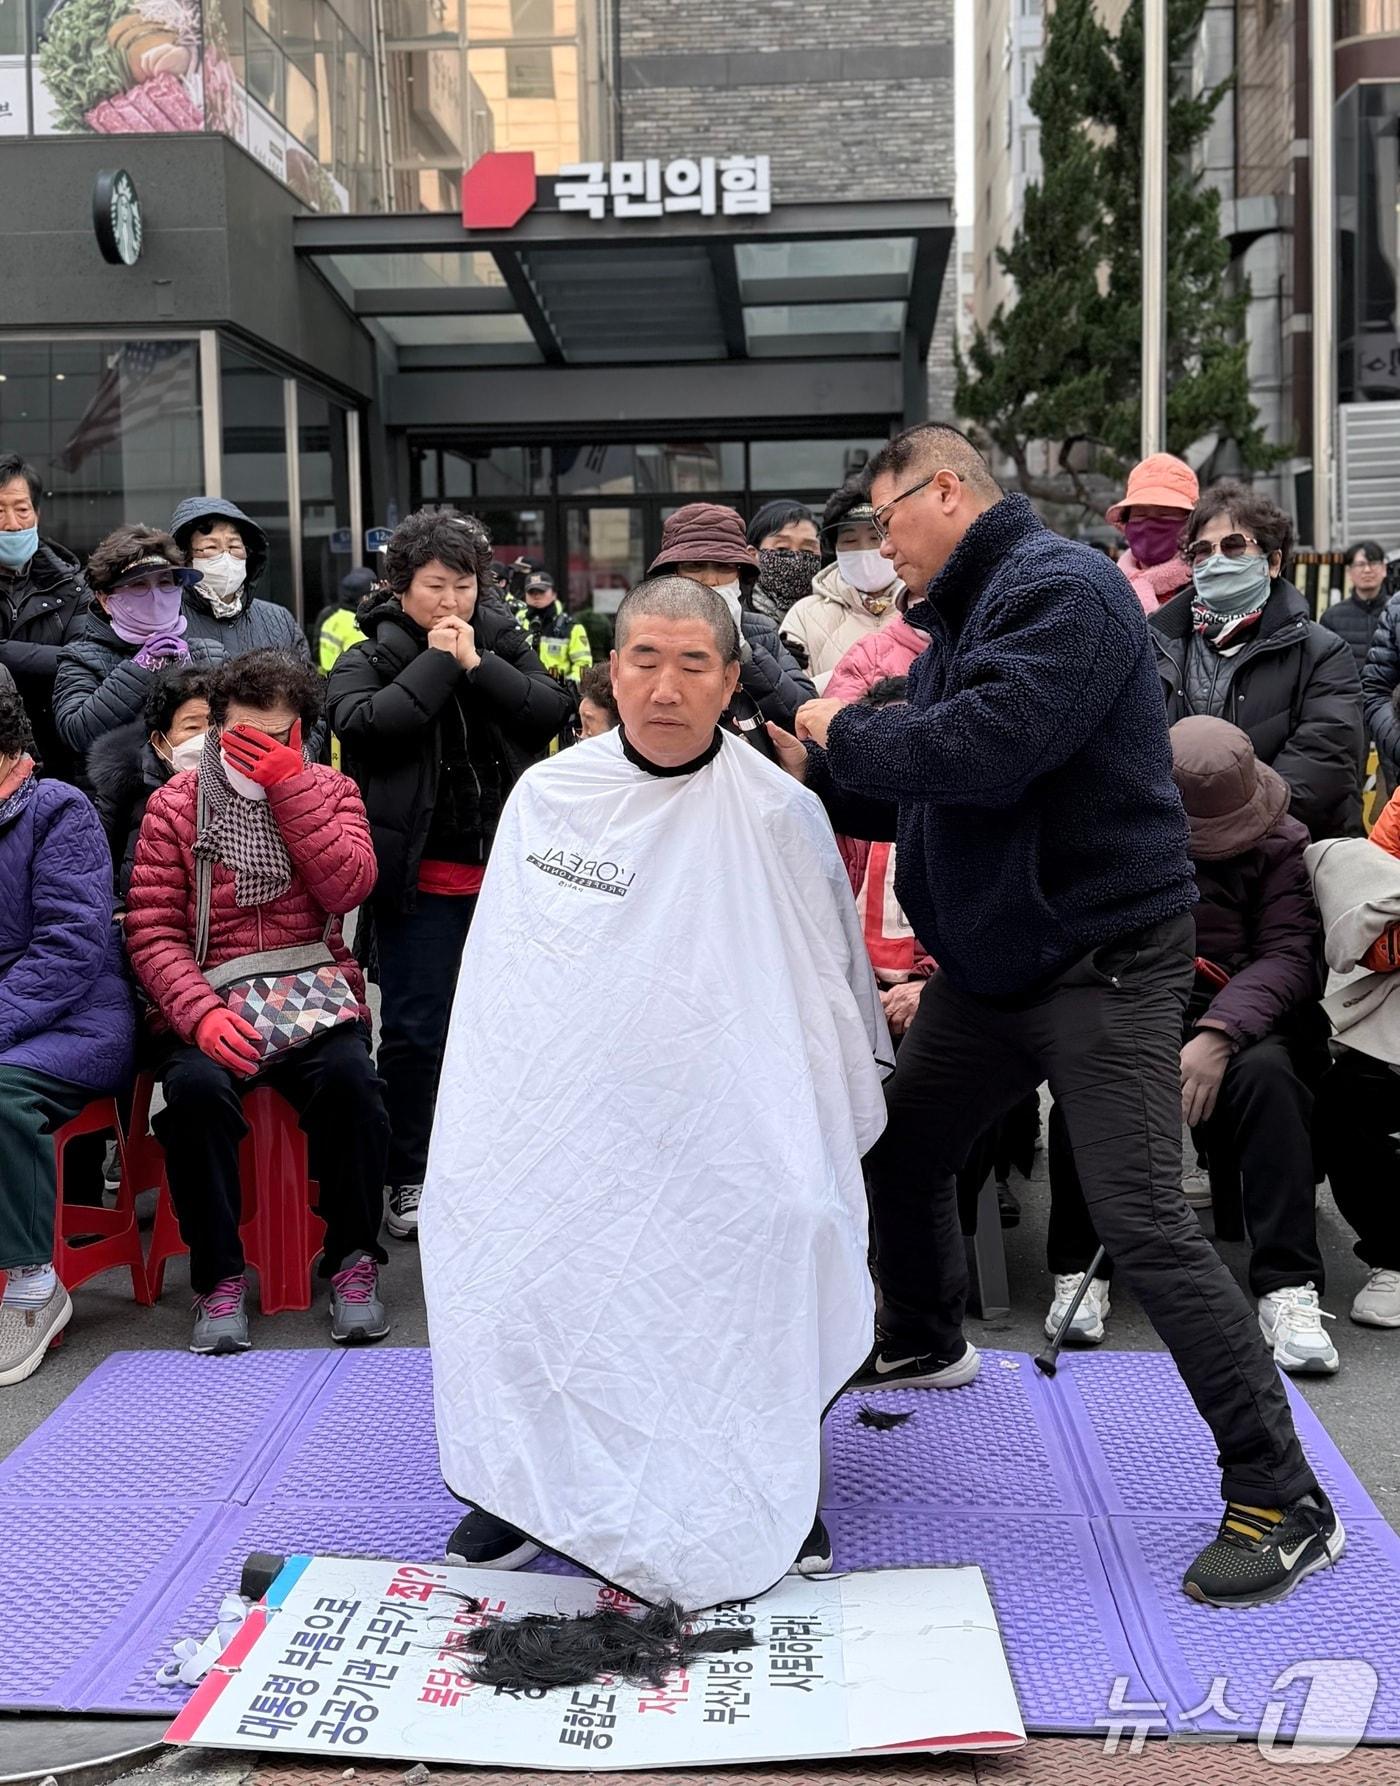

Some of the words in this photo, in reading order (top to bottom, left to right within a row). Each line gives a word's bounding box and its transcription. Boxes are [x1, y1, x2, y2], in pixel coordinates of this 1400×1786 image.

[554, 155, 771, 219] 국민의힘
[236, 1673, 320, 1739] 대통령
[278, 1597, 362, 1670] 부름으로
[769, 1615, 824, 1692] 사퇴하라!
[307, 1659, 399, 1744] 공공기관
[417, 1668, 476, 1707] 복당
[703, 1660, 754, 1725] 부산시당
[559, 1691, 616, 1750] 통합도
